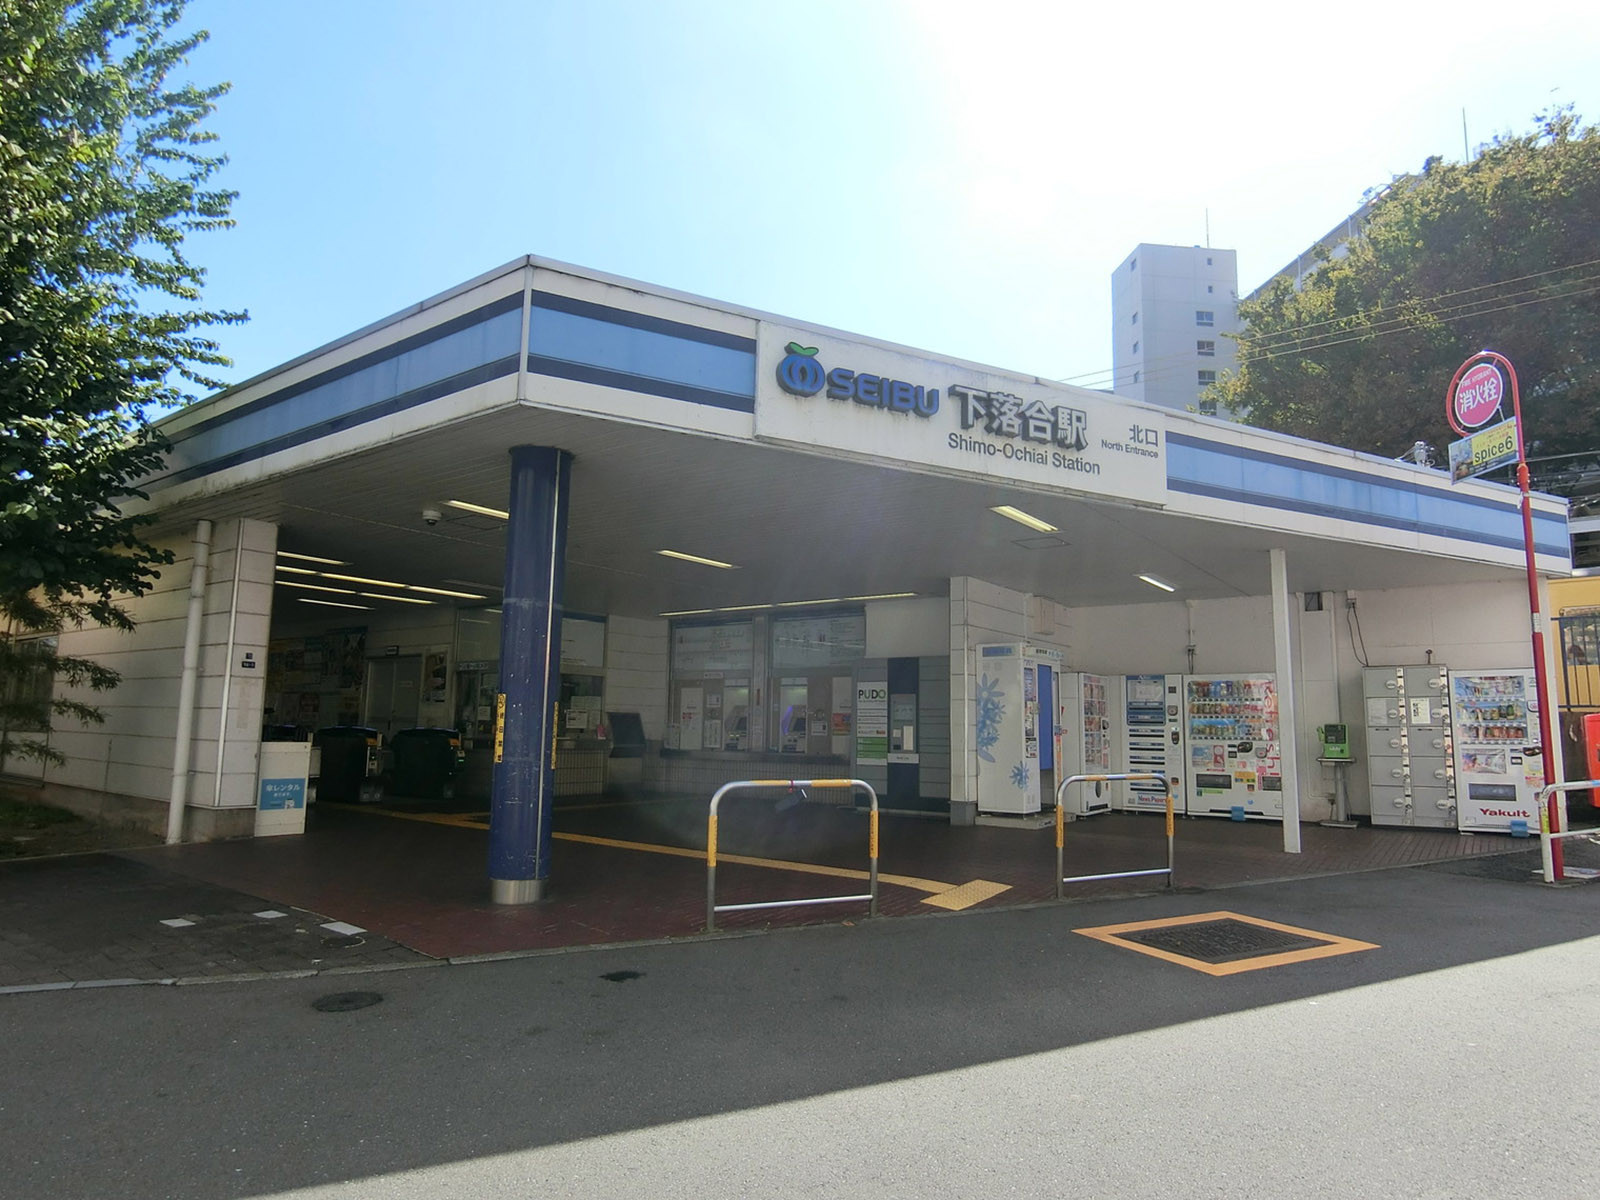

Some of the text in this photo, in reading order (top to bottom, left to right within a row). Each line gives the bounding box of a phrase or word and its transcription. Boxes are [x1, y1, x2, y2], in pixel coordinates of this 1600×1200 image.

[827, 367, 940, 418] SEIBU
[1459, 377, 1498, 414] 消火栓
[948, 384, 1089, 452] 下落合駅
[1100, 438, 1159, 459] North Entrance
[1128, 423, 1159, 447] 北口
[1474, 435, 1513, 463] spice6
[947, 431, 1101, 475] Shimo-Ochiai Station
[858, 689, 887, 699] PUDO
[1479, 807, 1531, 818] Yakult
